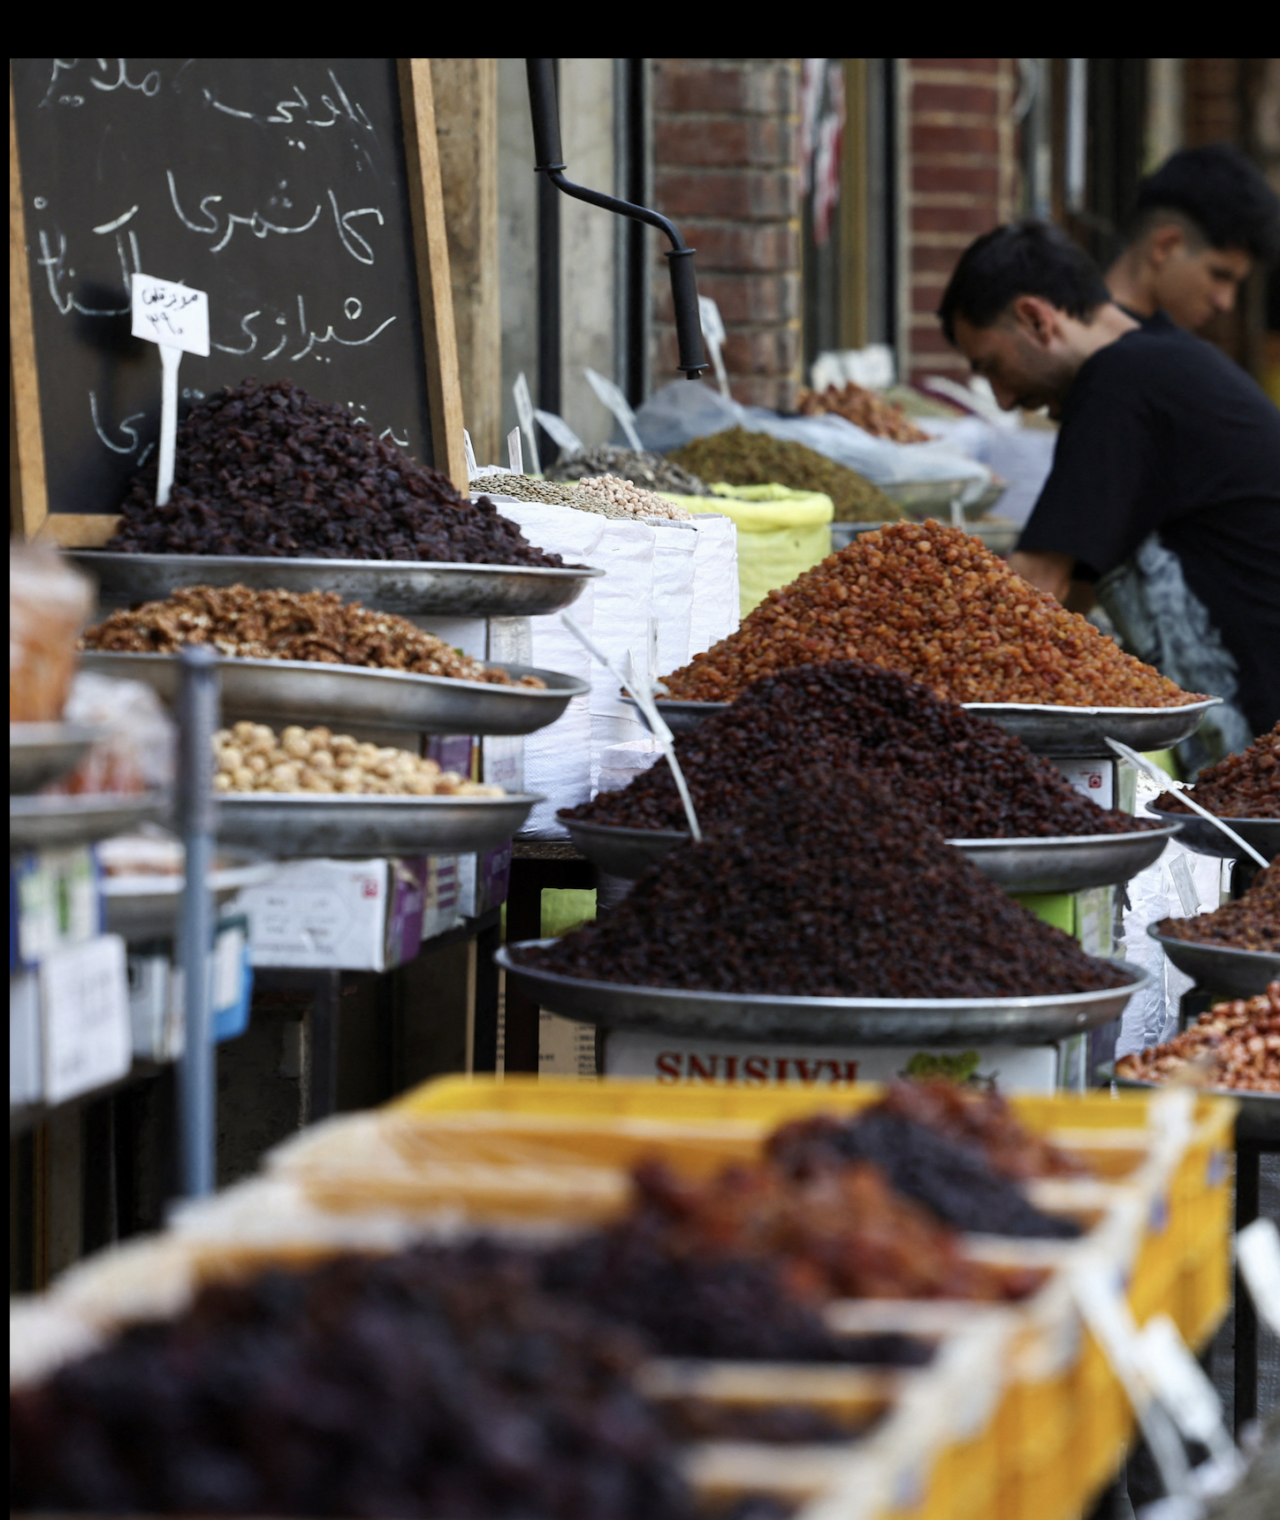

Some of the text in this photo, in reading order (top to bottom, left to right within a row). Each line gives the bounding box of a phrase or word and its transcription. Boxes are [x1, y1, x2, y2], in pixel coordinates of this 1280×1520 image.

[166, 169, 385, 266] کاشمری
[210, 295, 397, 364] شیرازی
[655, 1050, 861, 1090] RAISINS
